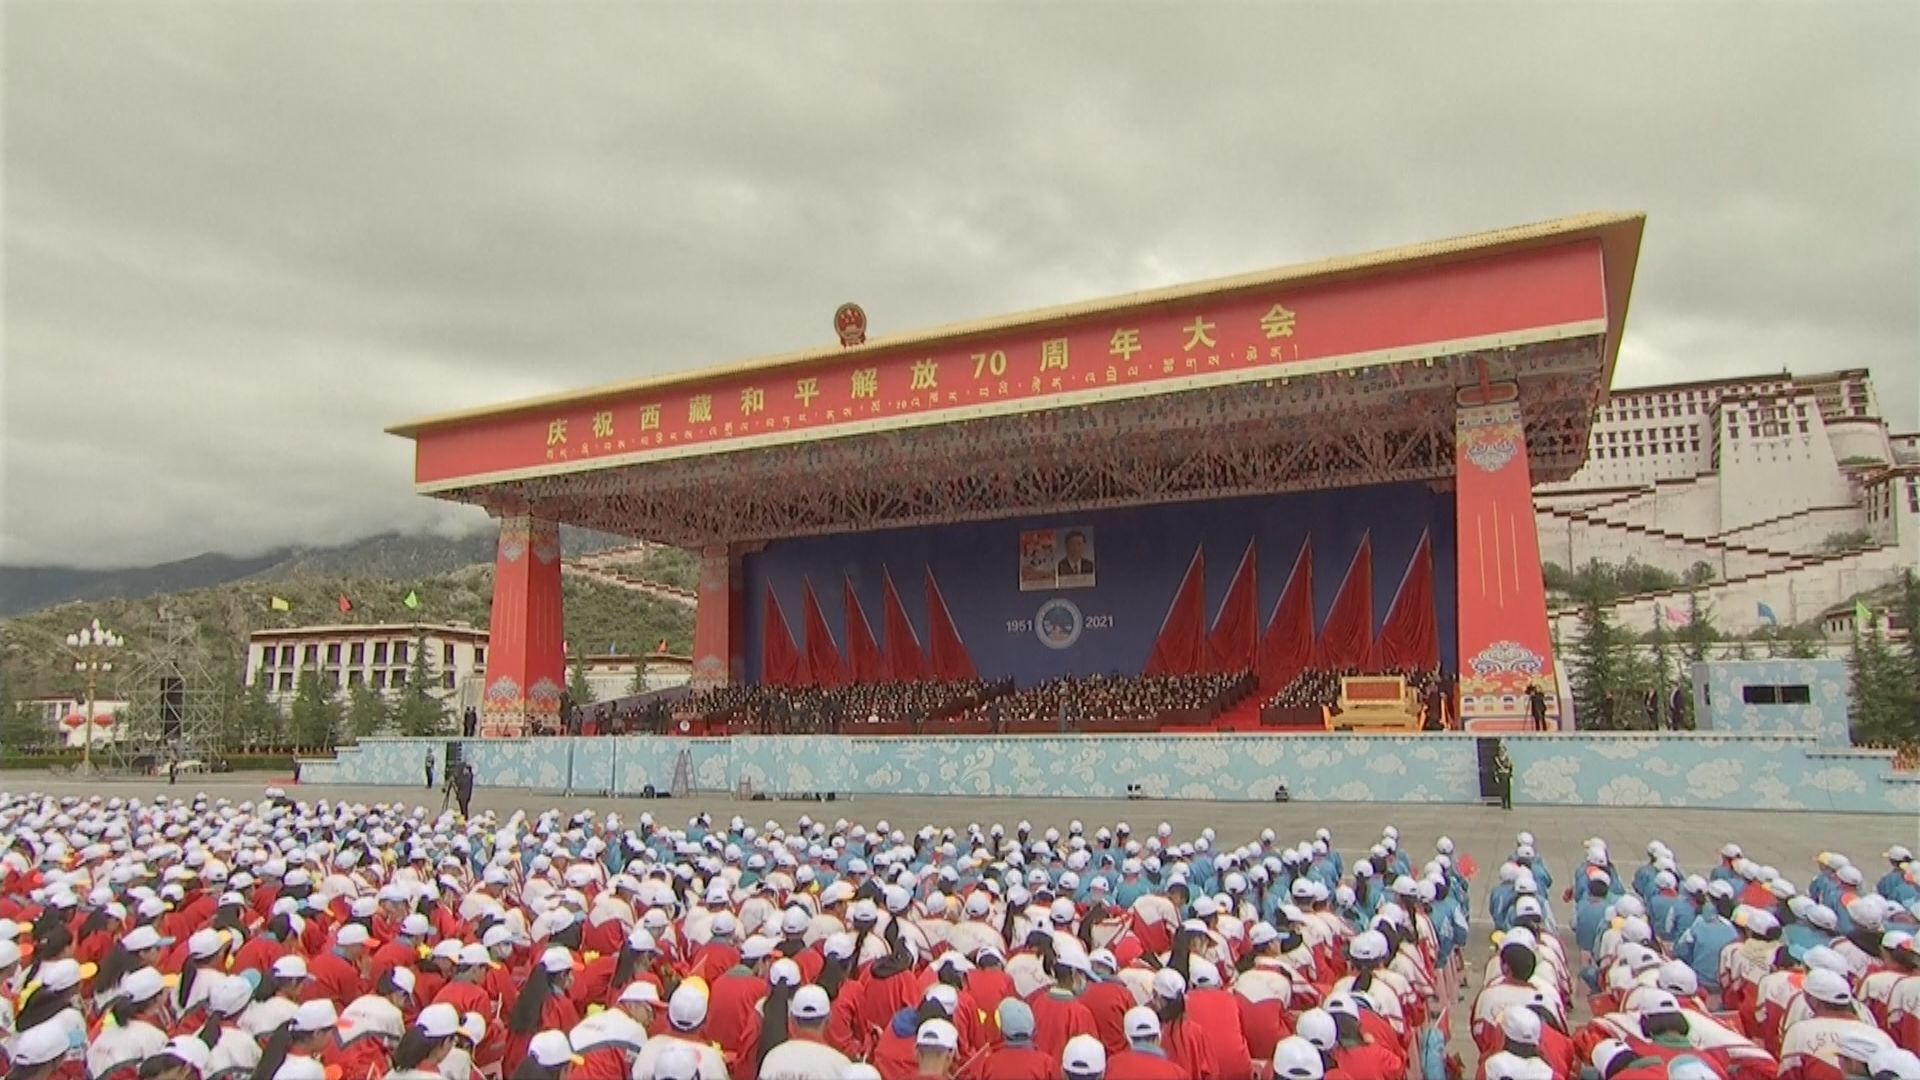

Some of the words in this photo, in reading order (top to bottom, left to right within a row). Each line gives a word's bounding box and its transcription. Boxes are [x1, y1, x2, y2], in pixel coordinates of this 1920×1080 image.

[546, 303, 1297, 446] 庆祝西藏和平解放70周年大会
[1006, 619, 1033, 633] 1951
[1085, 615, 1115, 629] 2021
